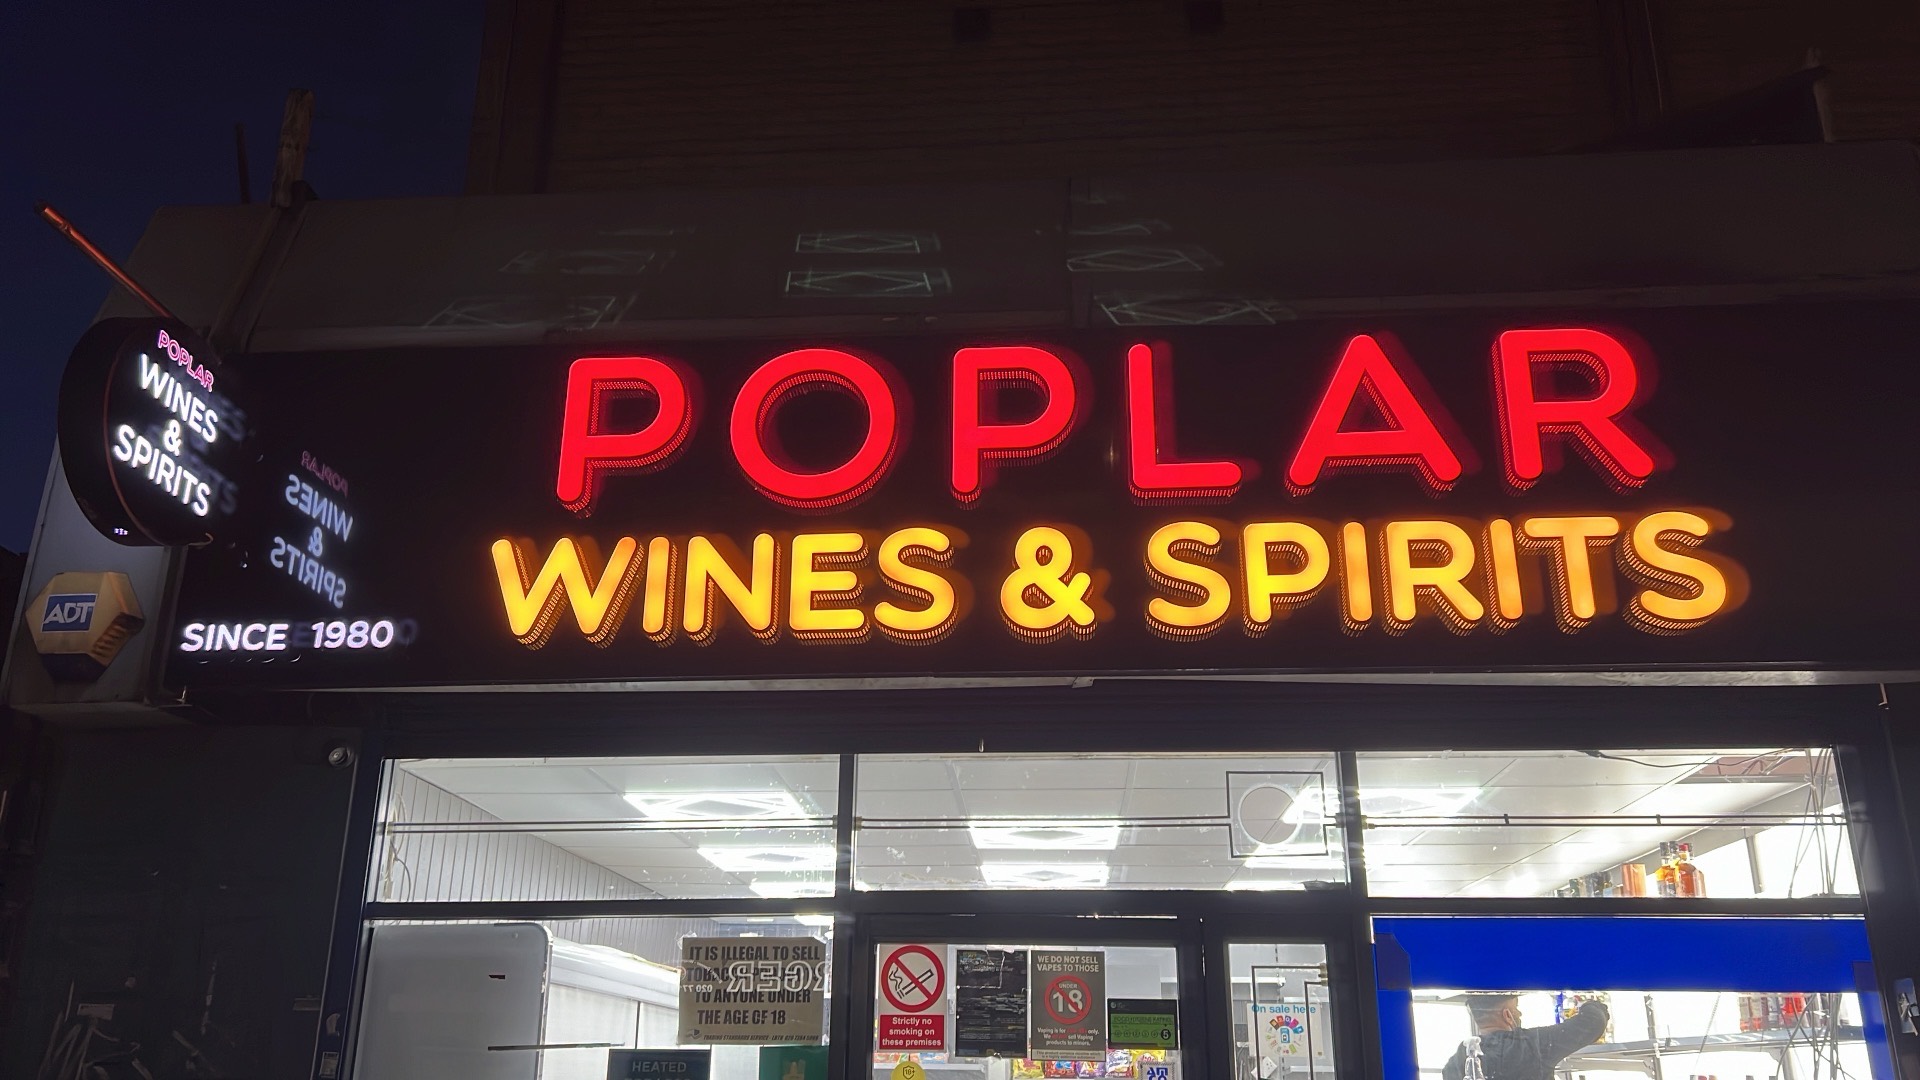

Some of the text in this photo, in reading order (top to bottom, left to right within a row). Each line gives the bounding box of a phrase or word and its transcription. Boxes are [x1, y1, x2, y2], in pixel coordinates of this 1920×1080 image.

[157, 329, 215, 392] POPLAR
[138, 352, 219, 444] WINES
[556, 328, 1655, 507] POPLAR
[161, 419, 183, 457] &
[112, 424, 212, 518] SPIRITS
[491, 511, 1729, 644] WINES & SPIRITS
[43, 602, 96, 625] ADT
[180, 619, 396, 653] SINCE 1980
[689, 946, 820, 960] IT IS ILLEGAL TO SELL
[1037, 955, 1098, 964] WE DO NOT SELL
[1037, 964, 1099, 972] VAPES TO THOSE
[714, 990, 764, 1003] ANYONE
[767, 989, 811, 1003] UNDER
[1052, 990, 1083, 1013] 18
[1251, 1005, 1316, 1013] On sale hee
[698, 1010, 786, 1024] THE AGE OF 18
[892, 1017, 921, 1026] Strictly
[889, 1028, 923, 1037] smoking
[882, 1038, 941, 1047] these premises
[632, 1061, 687, 1073] HEATED
